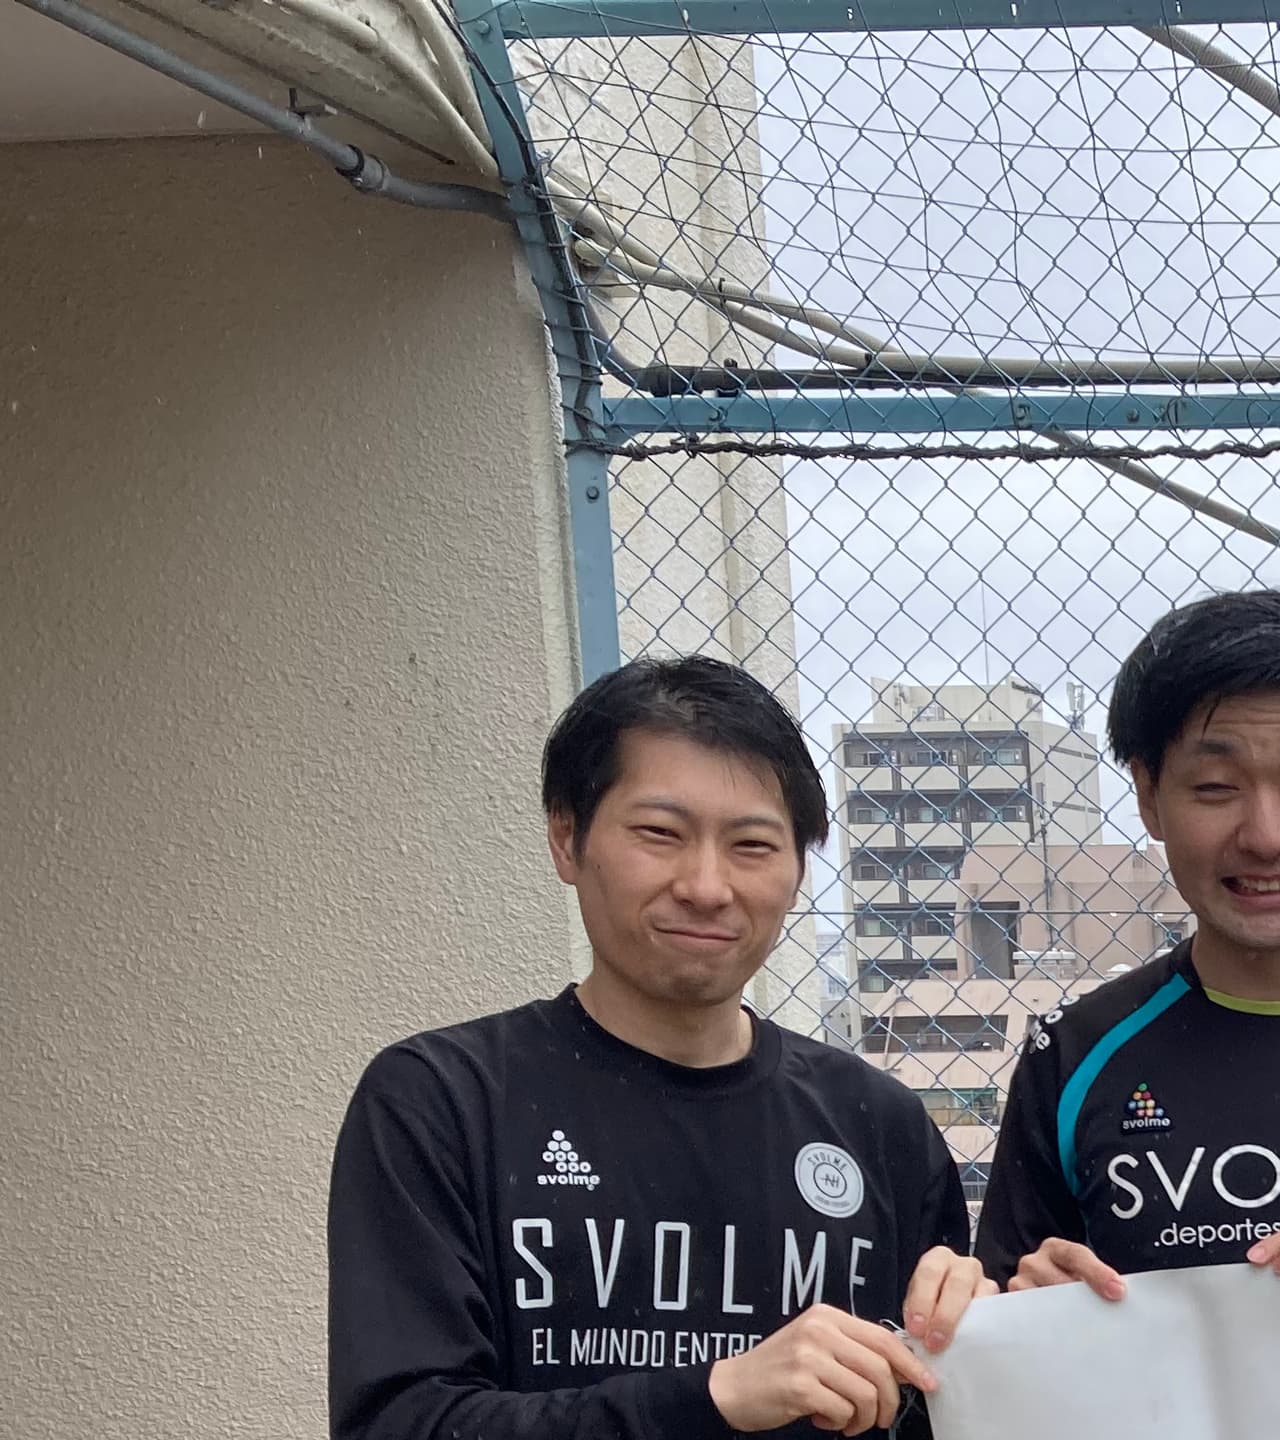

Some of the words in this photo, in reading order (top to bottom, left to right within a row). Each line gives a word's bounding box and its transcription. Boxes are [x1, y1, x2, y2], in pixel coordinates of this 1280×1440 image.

[1122, 1117, 1171, 1130] svolme
[537, 1172, 601, 1186] svolme
[512, 1217, 874, 1318] SVOLME
[532, 1328, 561, 1366] EL
[570, 1327, 665, 1368] MUNDO
